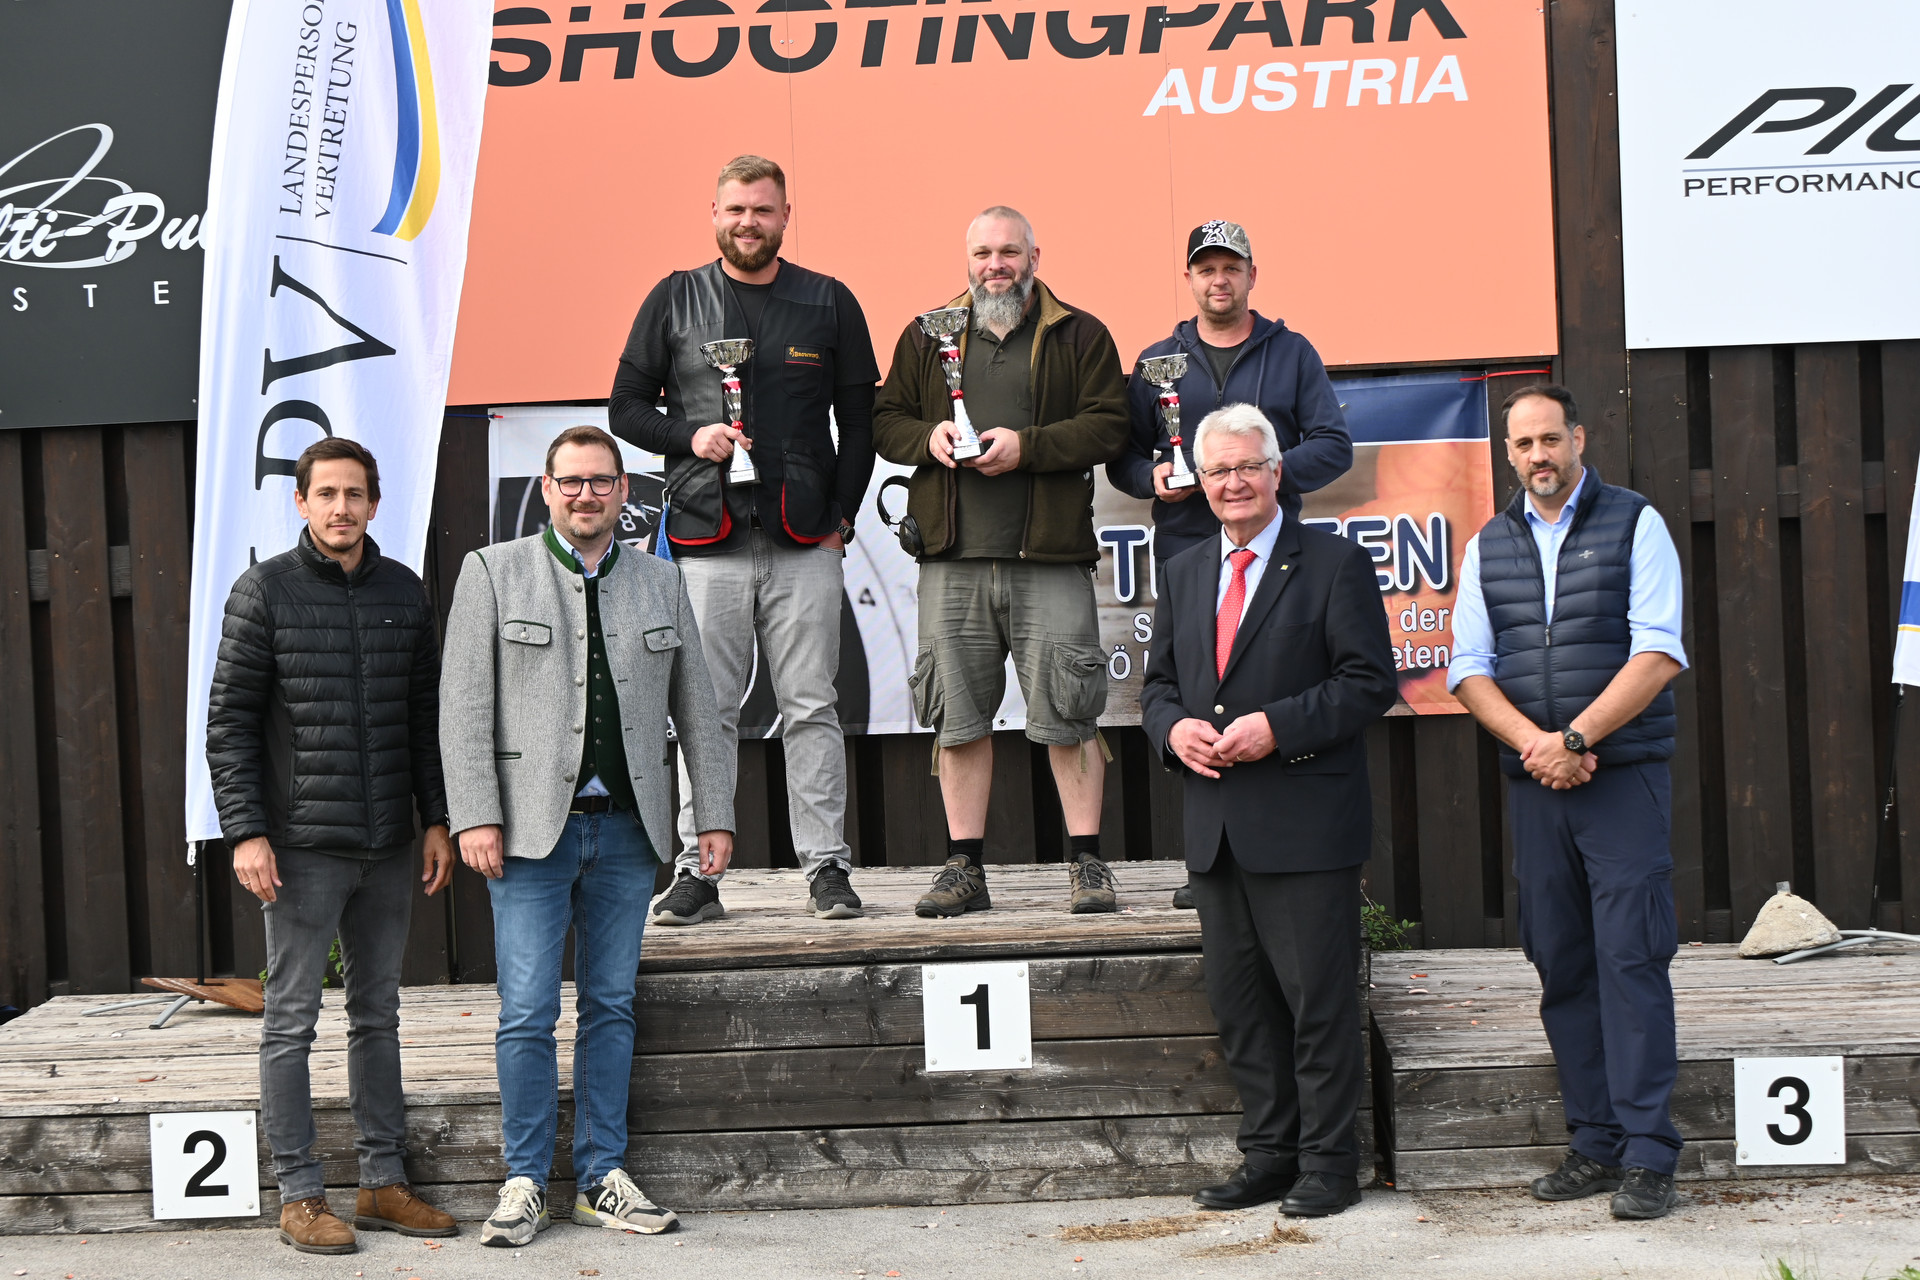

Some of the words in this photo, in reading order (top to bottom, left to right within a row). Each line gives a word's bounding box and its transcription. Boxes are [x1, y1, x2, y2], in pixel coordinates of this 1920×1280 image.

[279, 0, 325, 216] LANDESPERSO
[1142, 55, 1469, 116] AUSTRIA
[314, 21, 357, 219] VERTRETUNG
[1399, 601, 1450, 632] der
[960, 983, 991, 1050] 1
[1766, 1076, 1813, 1146] 3
[183, 1130, 229, 1197] 2
